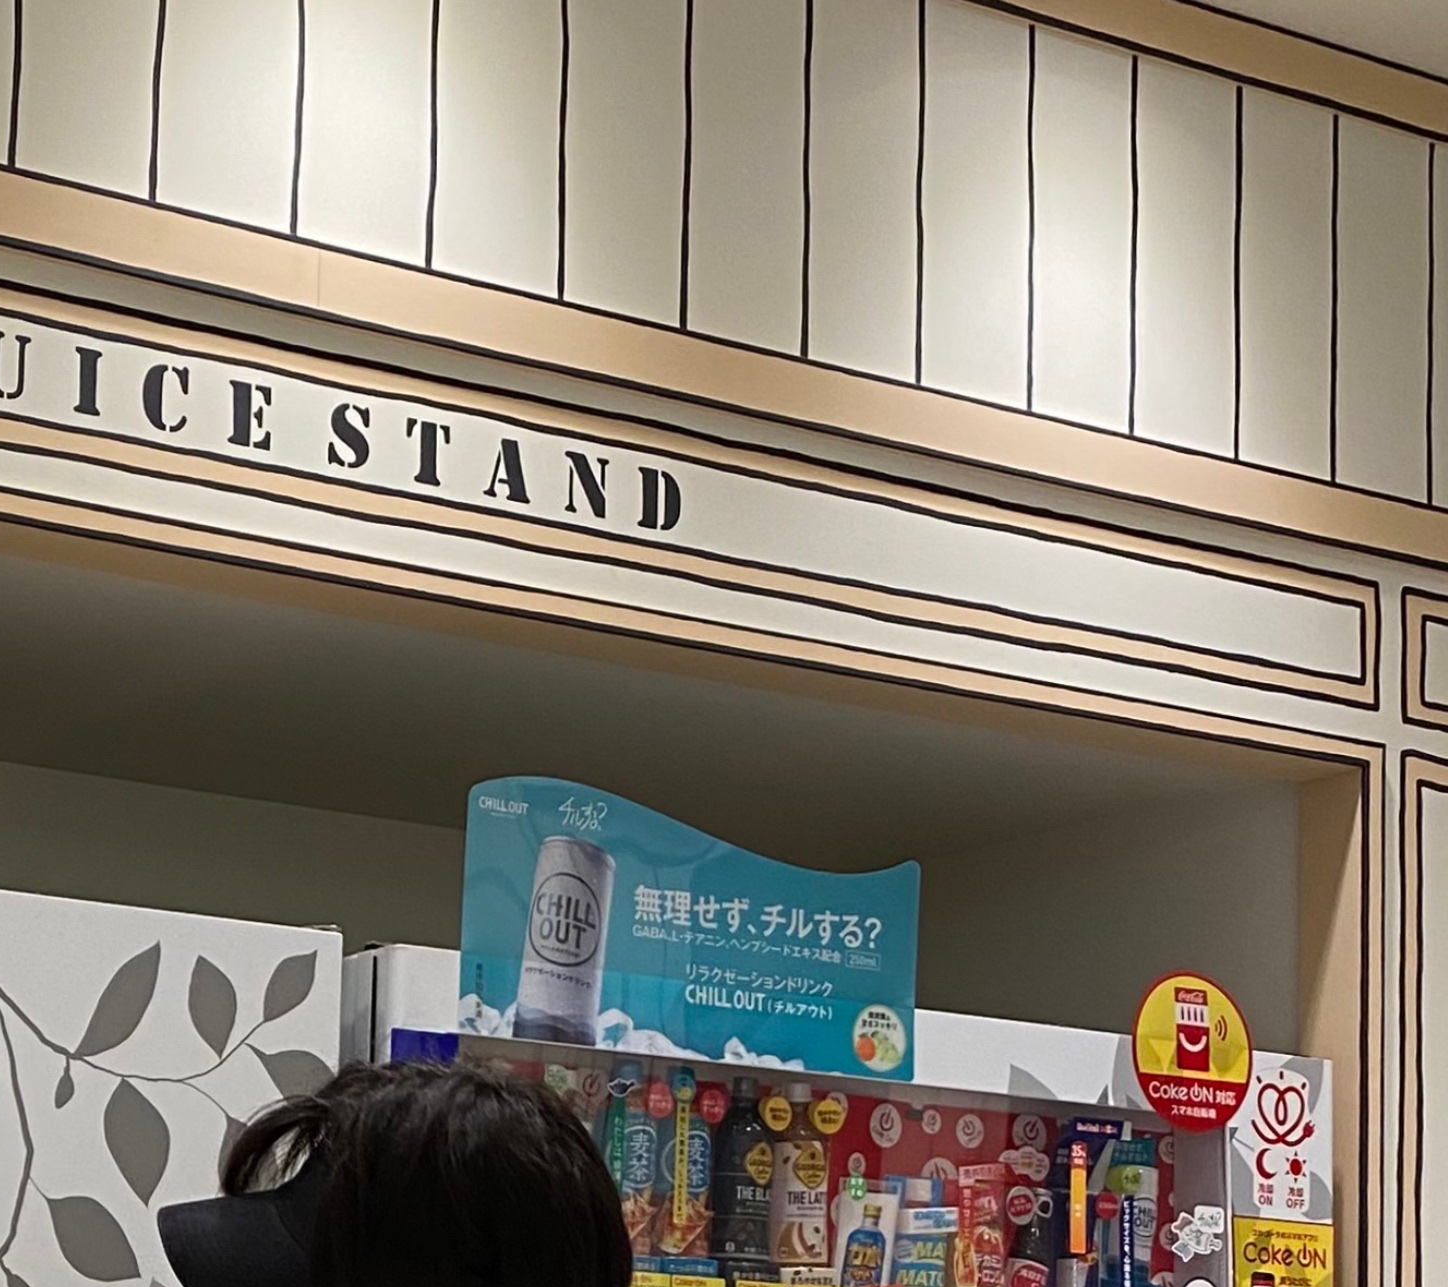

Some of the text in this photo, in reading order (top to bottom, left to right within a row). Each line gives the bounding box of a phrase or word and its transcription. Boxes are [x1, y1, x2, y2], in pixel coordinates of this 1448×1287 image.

[327, 402, 683, 532] STAND
[479, 796, 529, 814] CHILL OUT
[536, 894, 596, 930] CHILL
[539, 921, 586, 950] OUT
[686, 964, 833, 997] リラクゼーションドリンク
[685, 984, 732, 1008] CHILL
[733, 993, 766, 1012] OUT
[1149, 1081, 1236, 1105] Coke ON 対応
[629, 1132, 650, 1181] 麦茶
[788, 1192, 806, 1204] THE
[1258, 1195, 1273, 1206] ON
[1286, 1198, 1305, 1209] OFF
[1244, 1242, 1326, 1269] Coke ON
